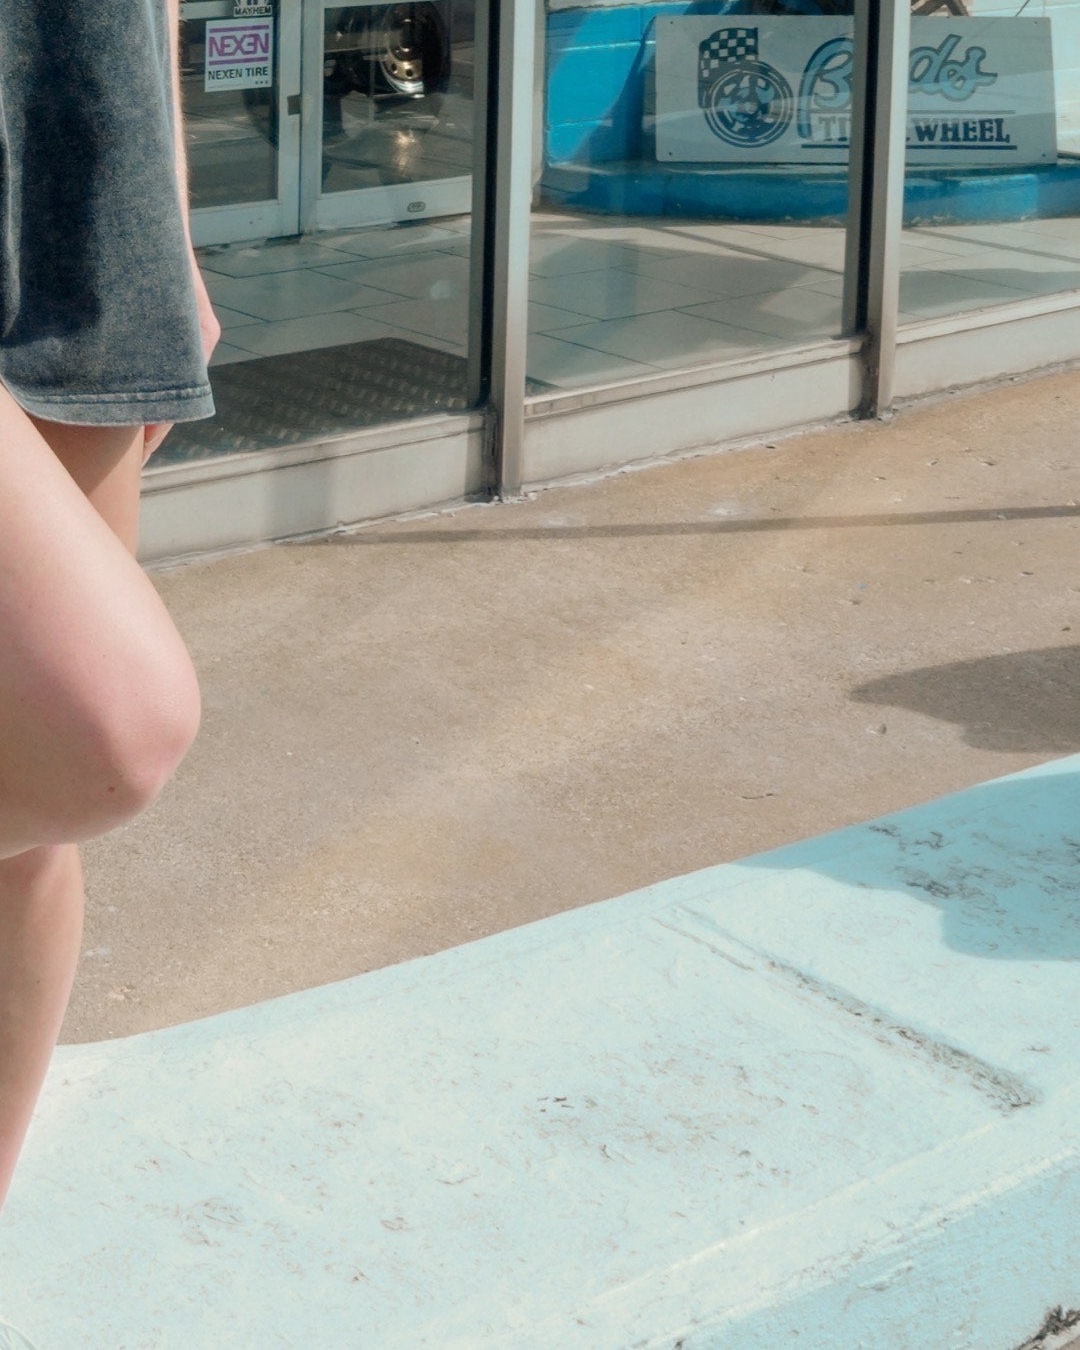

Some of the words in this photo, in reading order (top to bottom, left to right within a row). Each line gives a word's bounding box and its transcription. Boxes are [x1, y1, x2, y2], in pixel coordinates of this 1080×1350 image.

[235, 5, 271, 15] MAYHEM
[209, 33, 269, 58] NEXEN
[208, 69, 242, 81] NEXEN
[245, 66, 268, 77] TIRE
[913, 117, 1011, 143] WHEEL
